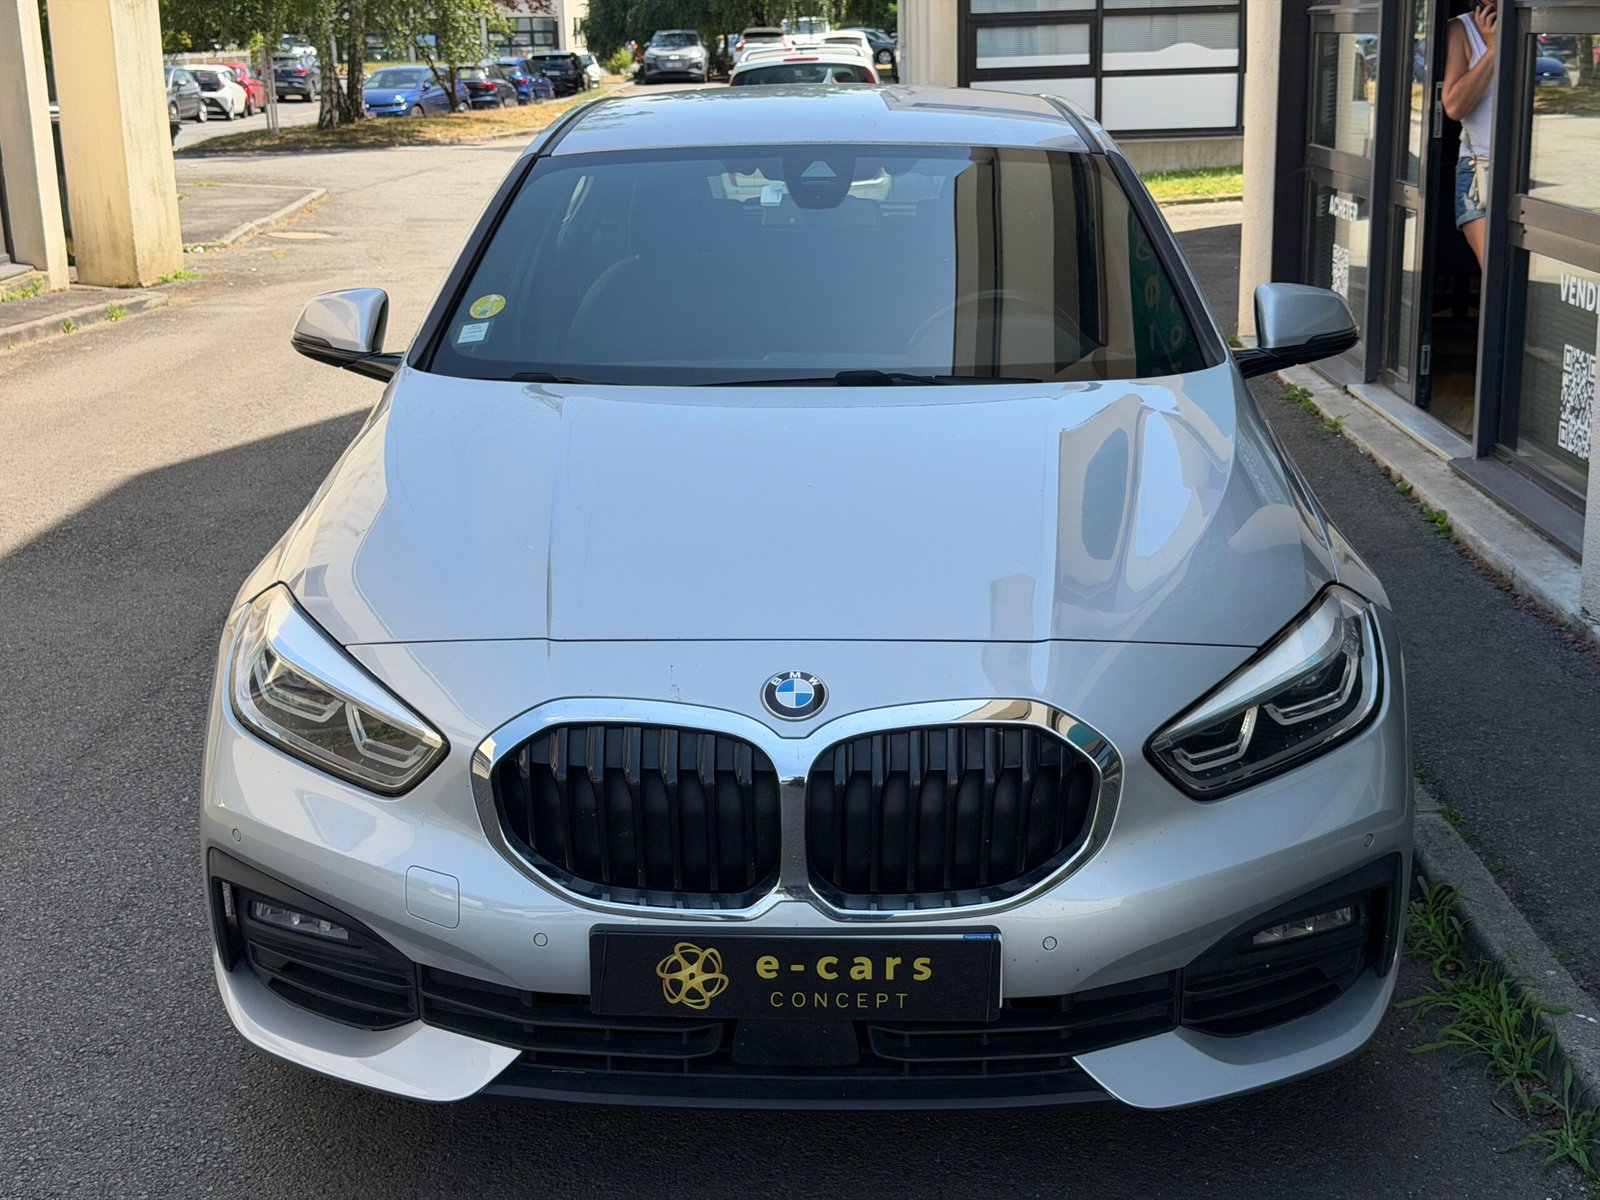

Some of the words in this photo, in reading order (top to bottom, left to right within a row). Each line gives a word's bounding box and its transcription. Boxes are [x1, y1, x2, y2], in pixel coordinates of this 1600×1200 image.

[1329, 195, 1358, 222] ACHETER
[770, 671, 821, 686] BMW
[756, 955, 932, 981] e-cars
[770, 992, 908, 1009] CONCEPT
